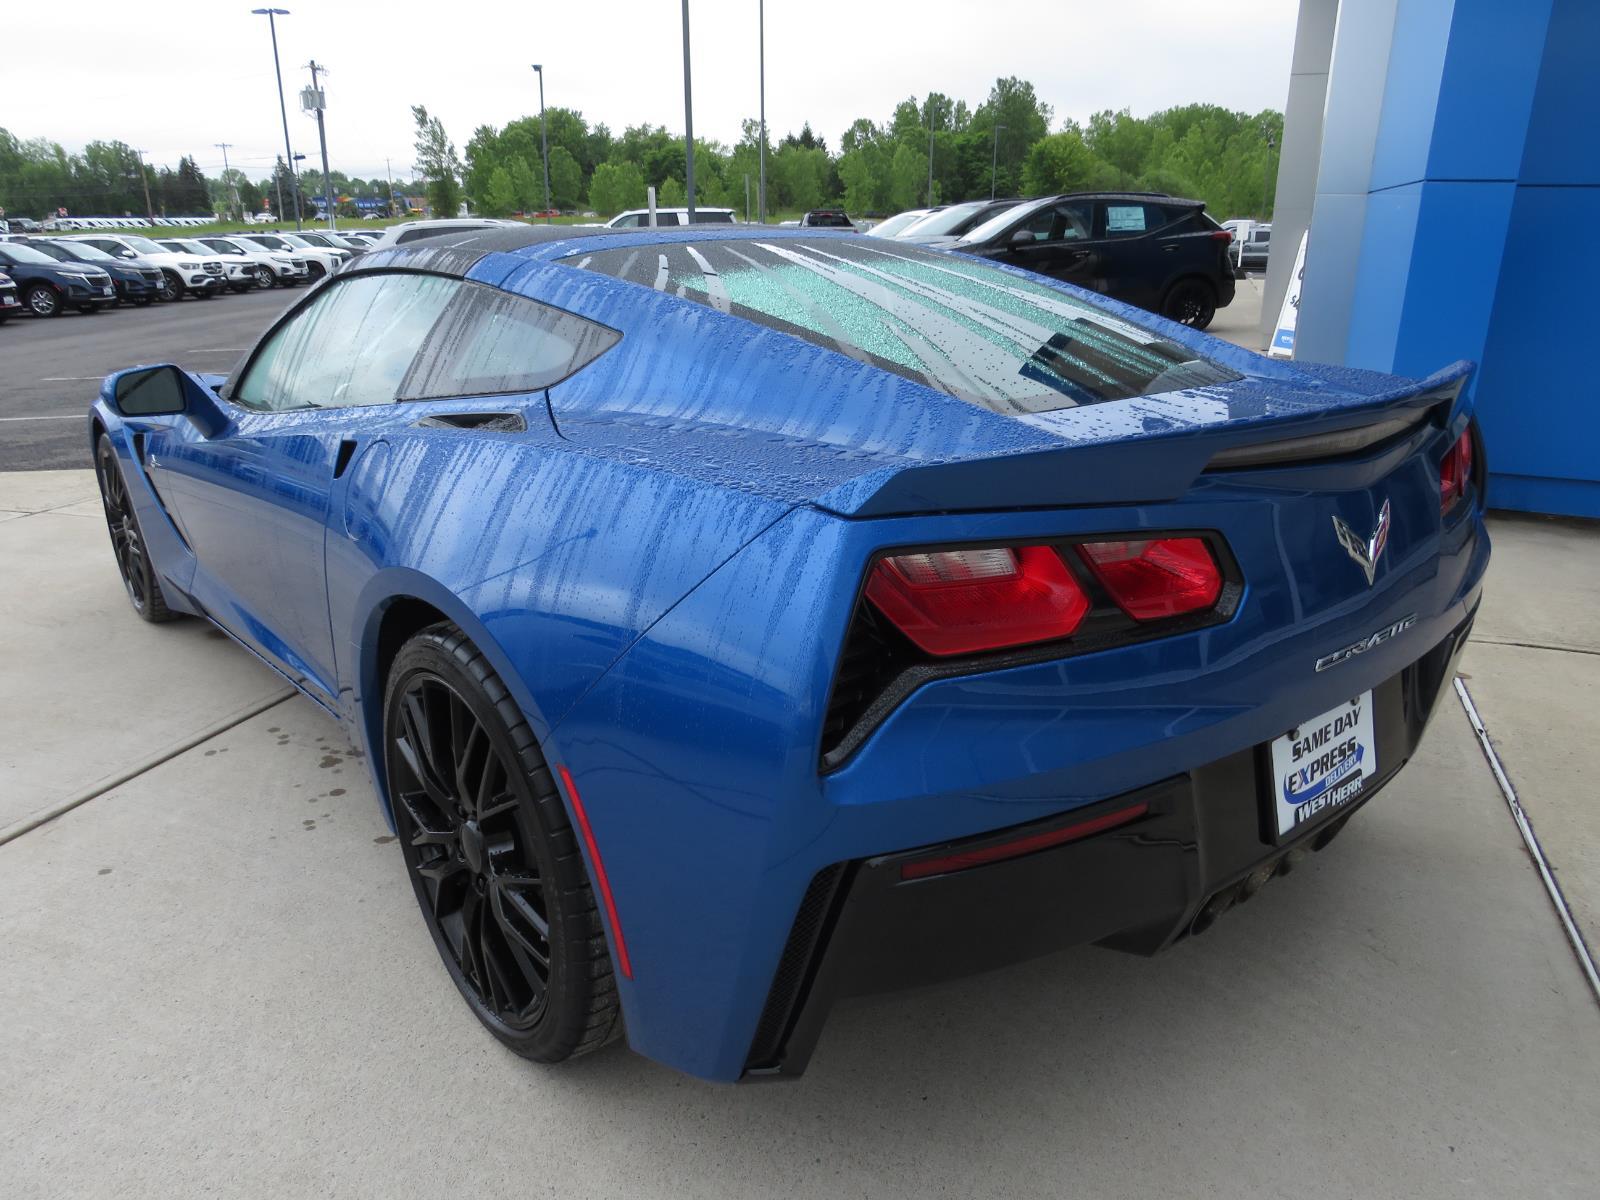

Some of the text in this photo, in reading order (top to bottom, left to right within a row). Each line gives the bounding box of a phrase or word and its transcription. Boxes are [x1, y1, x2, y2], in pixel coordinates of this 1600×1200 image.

[1292, 706, 1361, 763] SAME DAY
[1288, 736, 1356, 793] EXPRESS
[1325, 752, 1357, 787] DELIVERY
